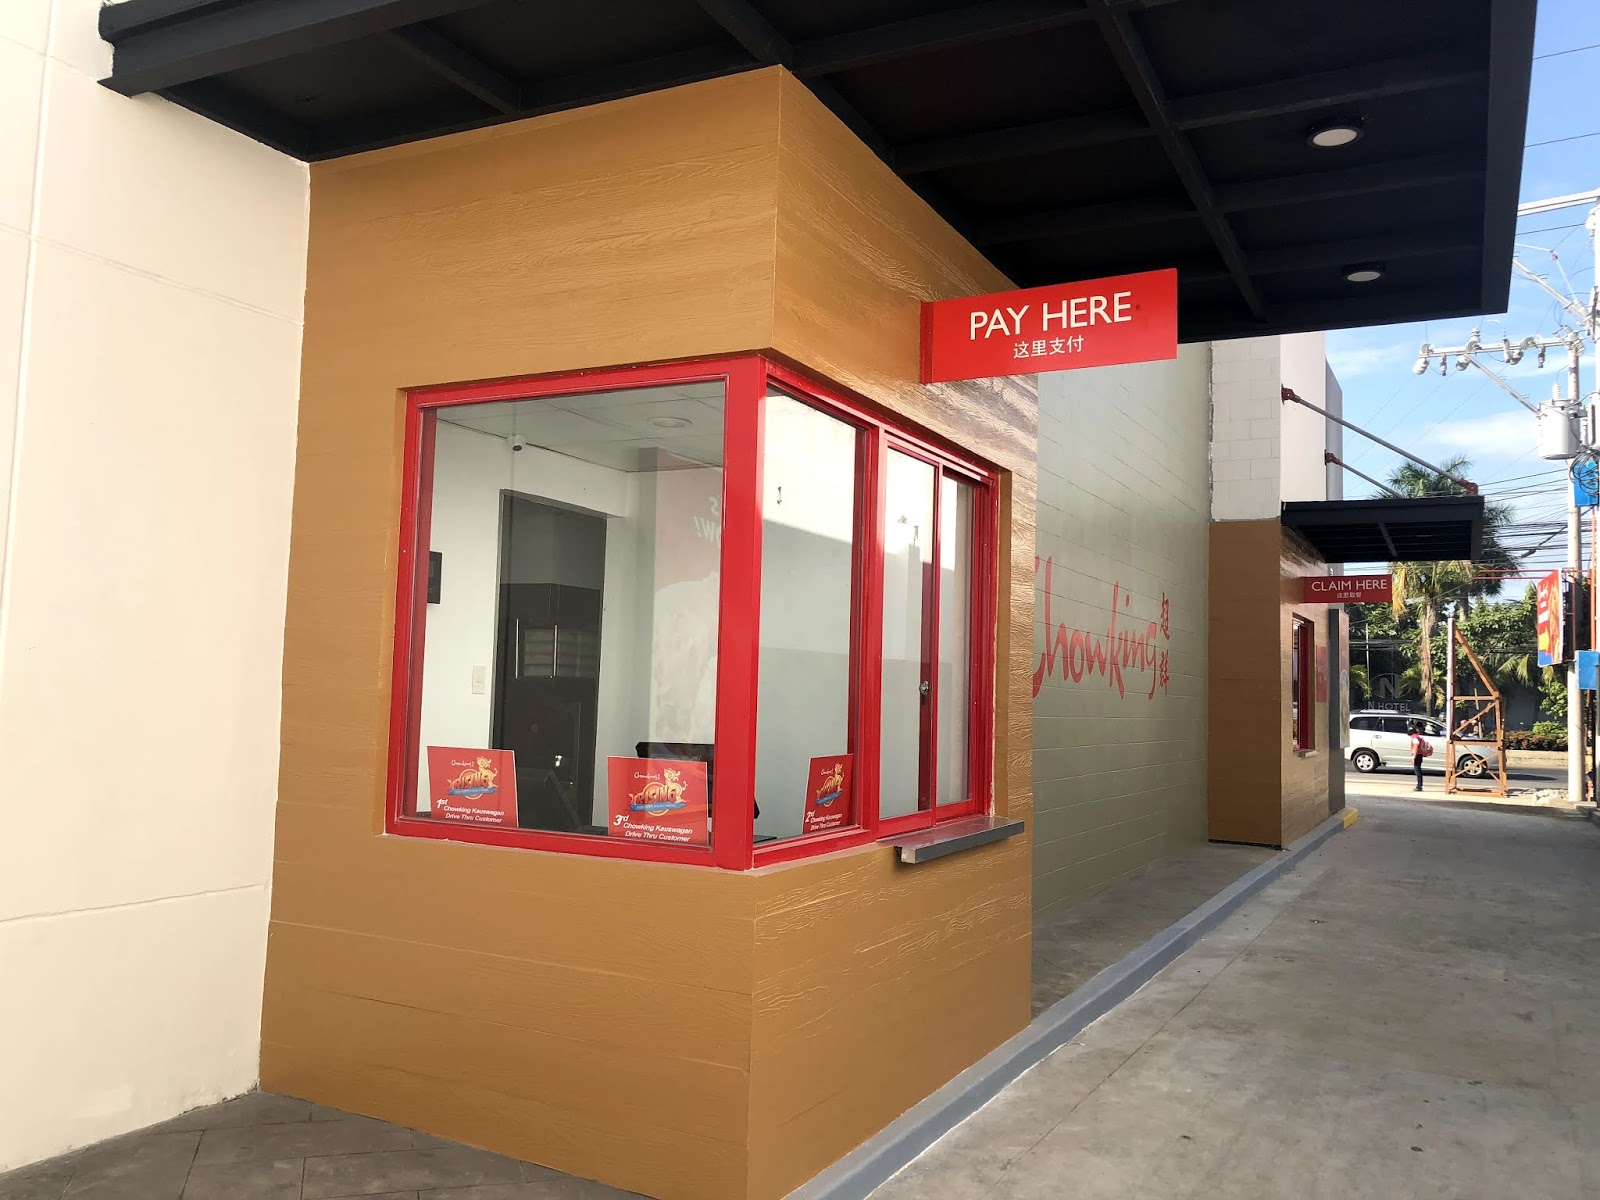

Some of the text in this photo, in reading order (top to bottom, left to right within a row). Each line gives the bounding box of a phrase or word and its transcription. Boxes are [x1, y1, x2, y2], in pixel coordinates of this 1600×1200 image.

[970, 291, 1132, 341] PAY HERE
[1013, 334, 1084, 359] 这里支付
[1311, 579, 1388, 592] CLAIM HERE
[1367, 701, 1411, 711] N HOTEL
[436, 798, 448, 809] 1st
[443, 805, 505, 817] Chowking Kauswagan
[445, 812, 461, 820] Drive
[475, 815, 502, 823] Customer
[613, 814, 630, 826] 3rd
[623, 822, 693, 835] Chowking Kauswagan
[625, 830, 642, 838] Drive
[659, 833, 691, 842] Customer
